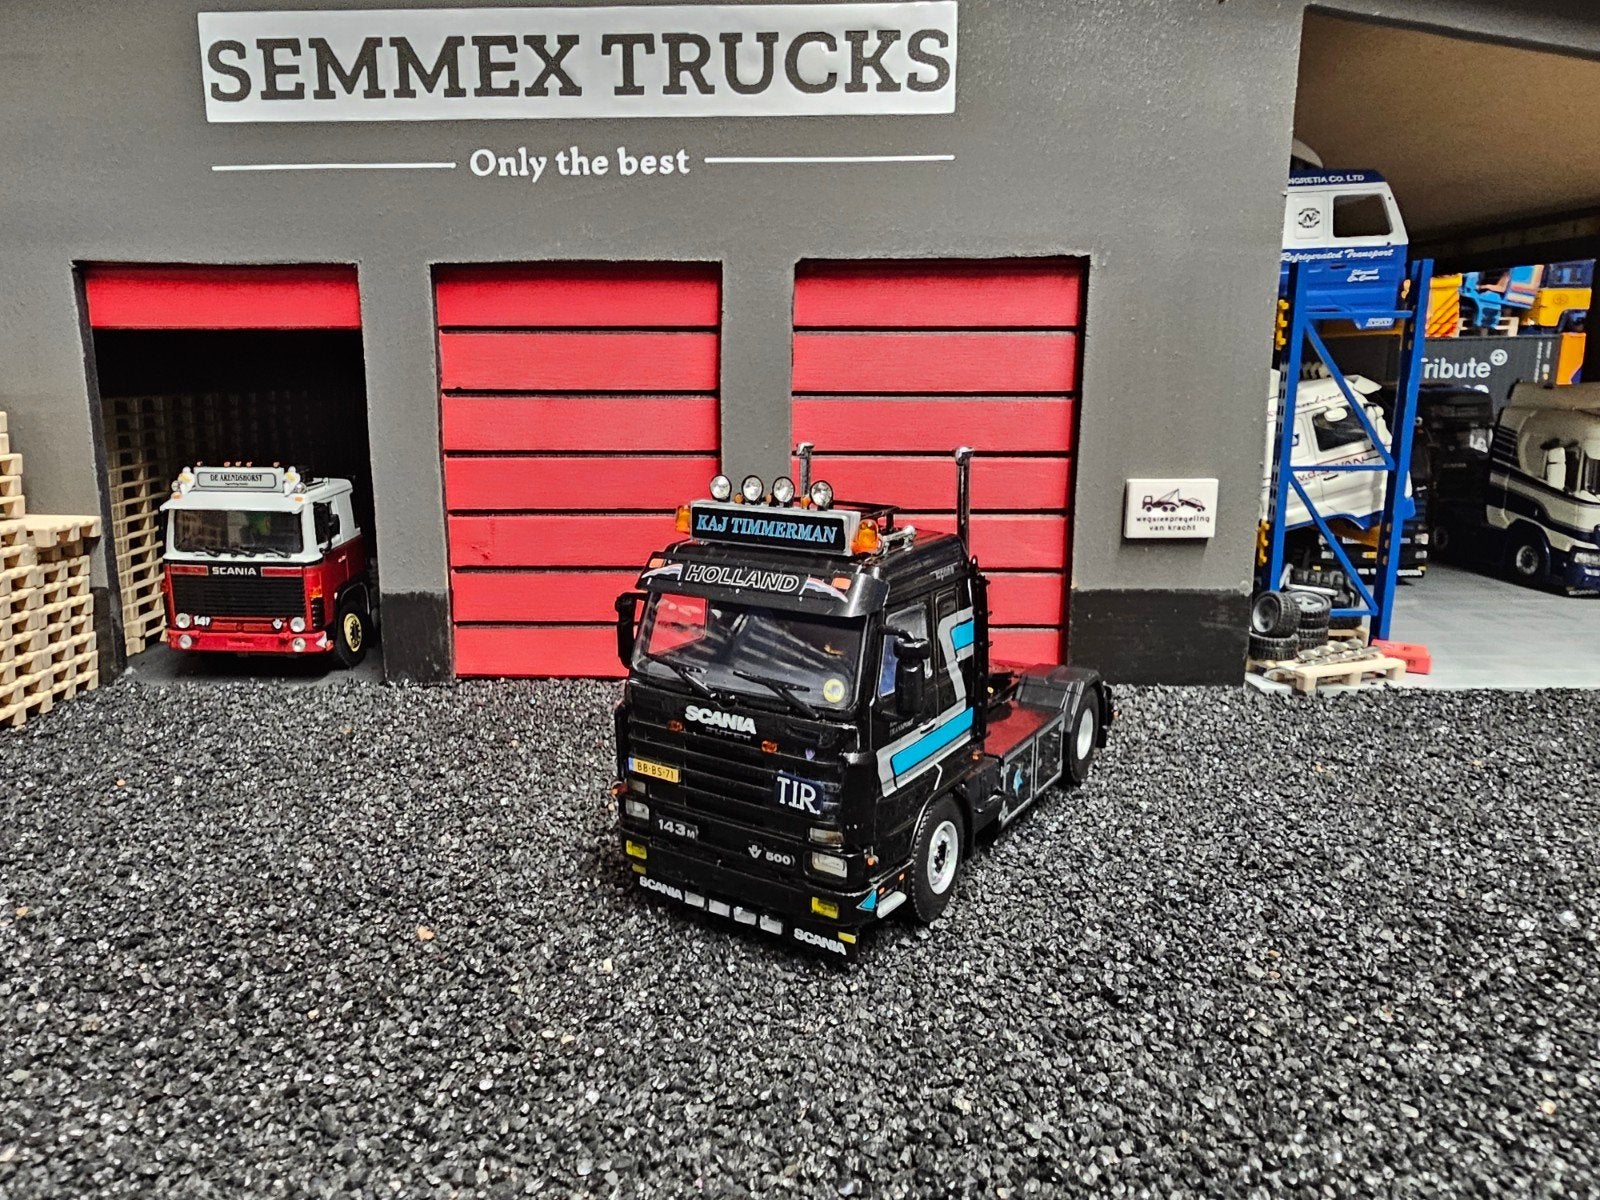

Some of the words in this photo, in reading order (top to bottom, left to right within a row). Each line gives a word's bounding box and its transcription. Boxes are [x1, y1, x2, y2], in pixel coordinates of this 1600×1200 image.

[206, 34, 583, 103] SEMMEX
[600, 28, 951, 98] TRUCKS
[469, 148, 548, 183] Only
[554, 149, 610, 178] the
[619, 148, 691, 176] best
[1420, 356, 1491, 379] ribute
[696, 514, 729, 533] KAJ
[731, 517, 838, 544] TIMMERMAN
[212, 566, 257, 576] SCANIA
[685, 564, 800, 593] HOLLAND
[684, 704, 757, 735] SCANIA
[777, 776, 821, 815] TIR
[765, 851, 791, 866] 500
[639, 875, 684, 901] SCANIA
[793, 928, 848, 956] SCANIA
